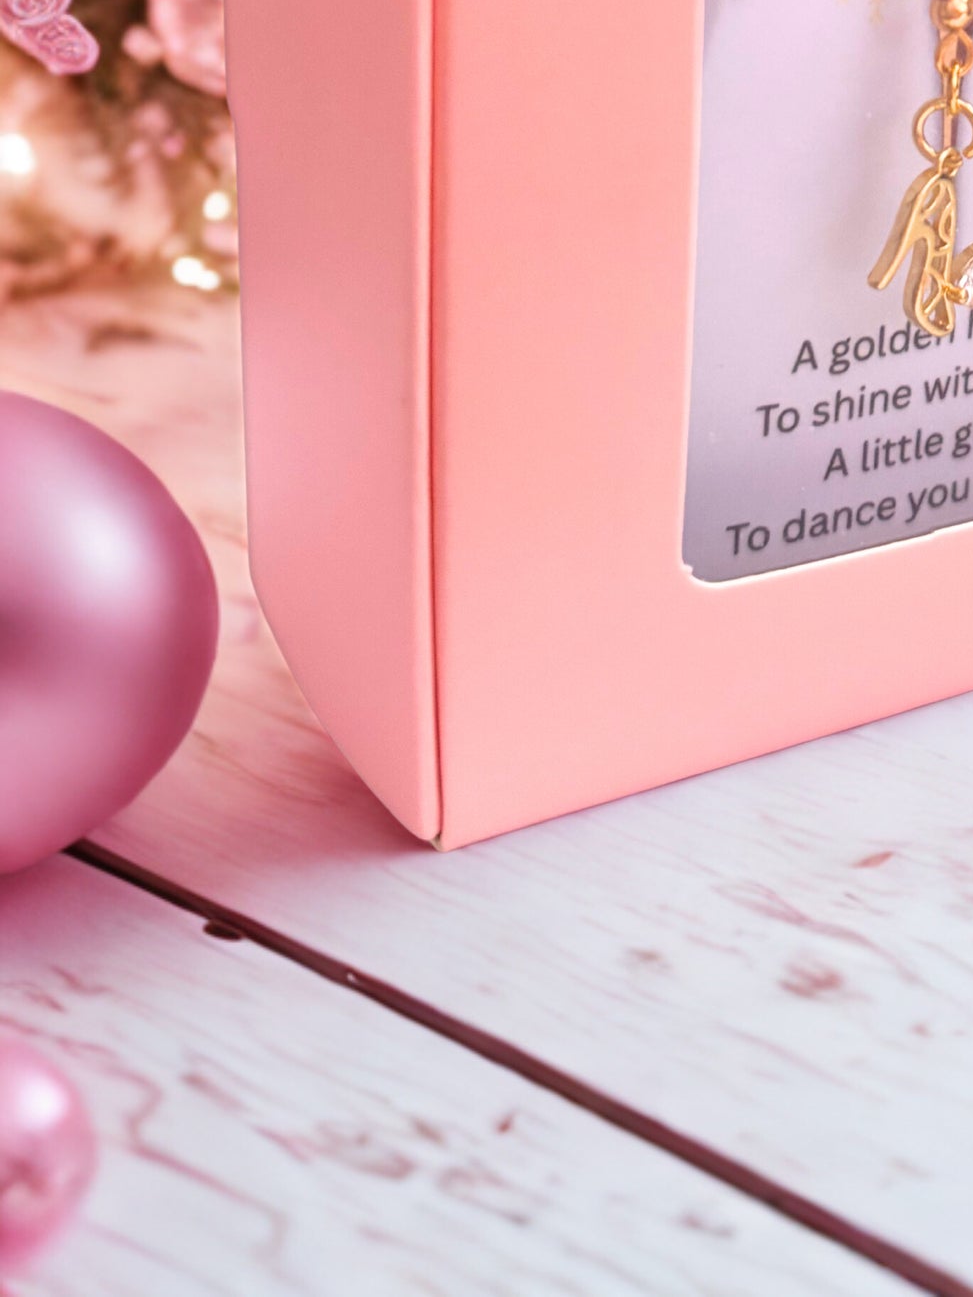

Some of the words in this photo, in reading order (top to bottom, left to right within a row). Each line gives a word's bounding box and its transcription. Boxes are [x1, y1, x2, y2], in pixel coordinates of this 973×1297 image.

[791, 339, 818, 375] A
[756, 403, 799, 437] To
[812, 385, 912, 427] shine
[823, 447, 849, 481] A
[862, 429, 944, 472] little
[726, 522, 770, 555] To
[782, 496, 897, 544] dance
[905, 477, 970, 523] you
